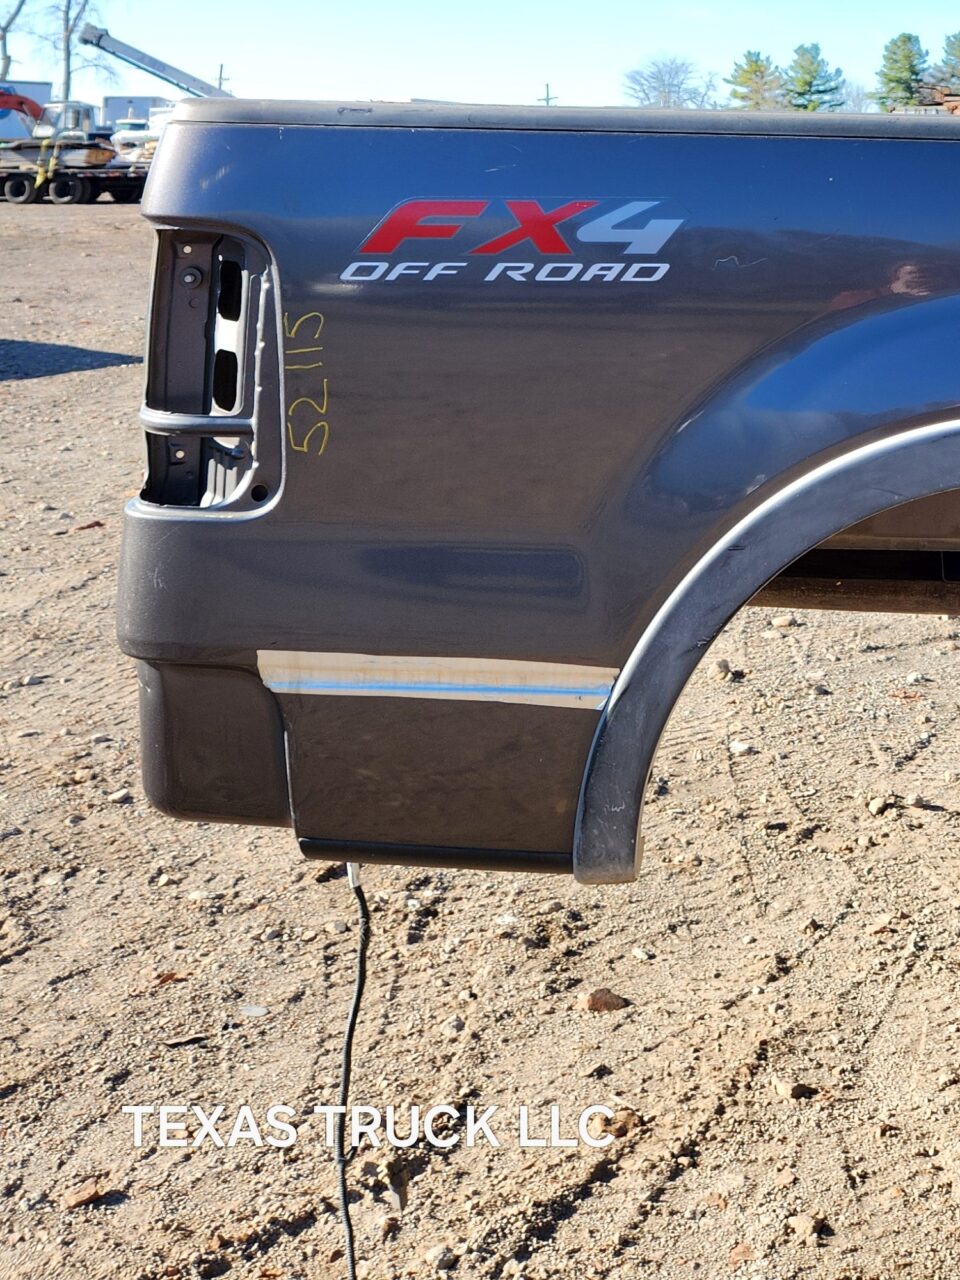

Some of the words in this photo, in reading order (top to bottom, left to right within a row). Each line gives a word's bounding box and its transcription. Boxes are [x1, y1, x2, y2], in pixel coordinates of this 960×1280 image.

[358, 199, 685, 255] FX4
[339, 261, 468, 282] OFF
[483, 262, 671, 282] ROAD
